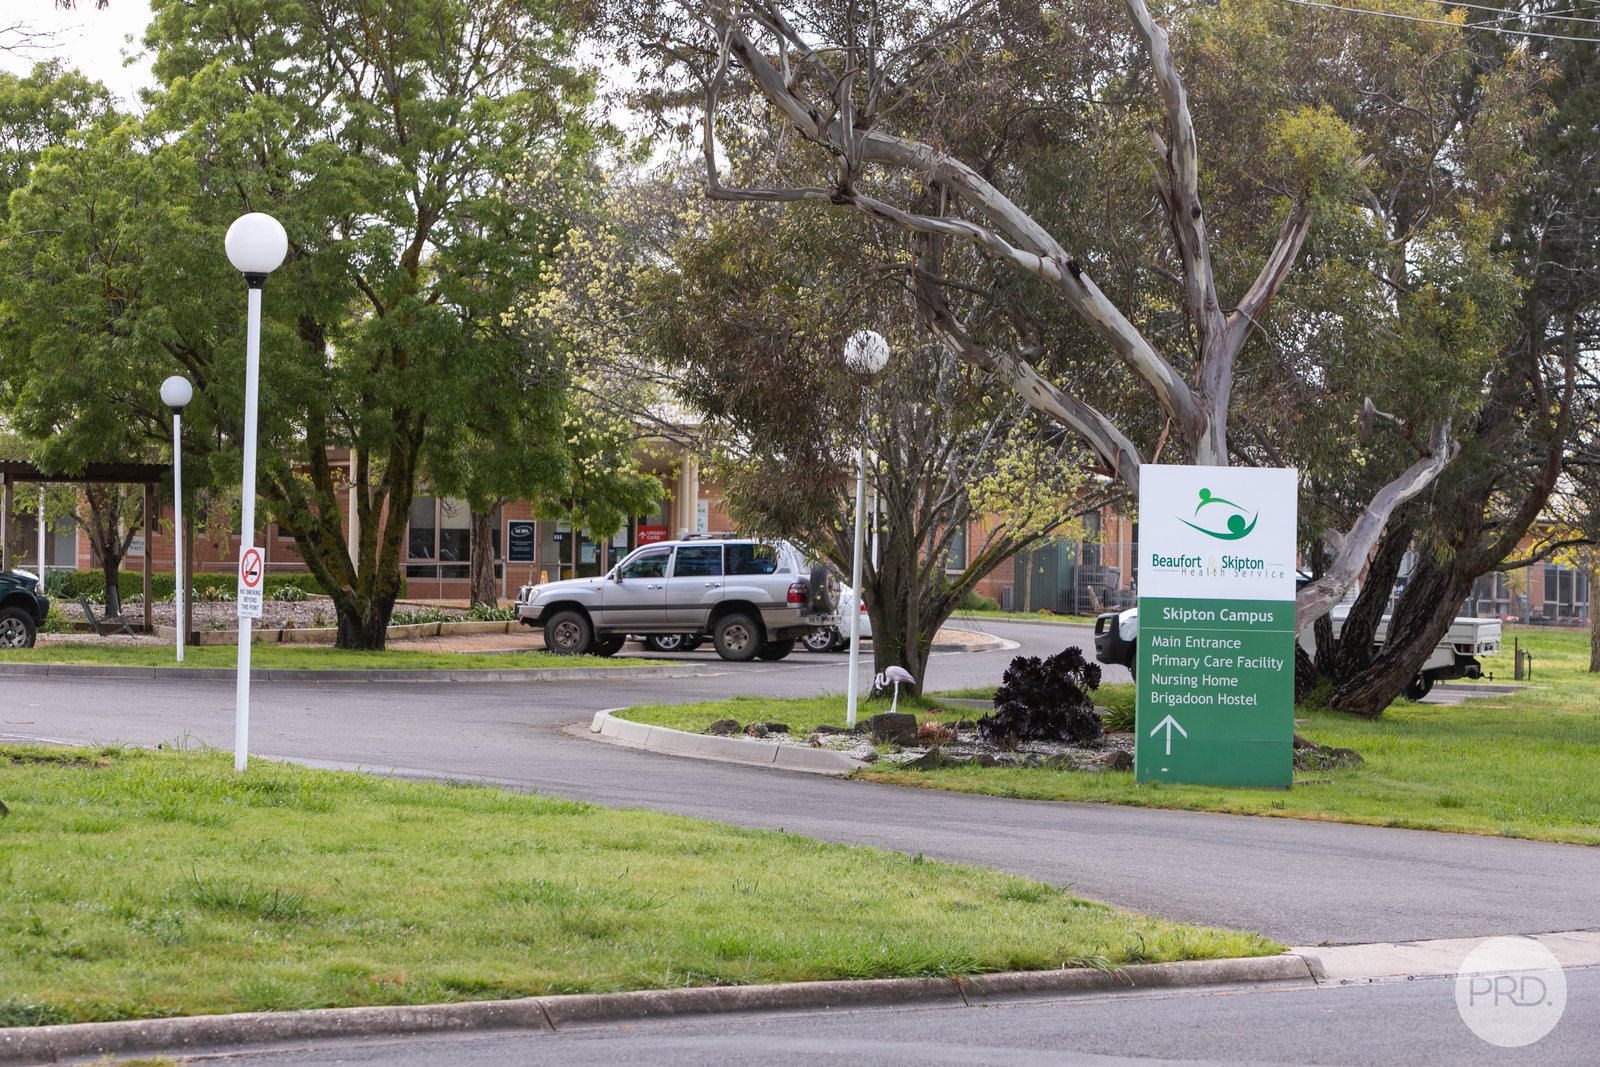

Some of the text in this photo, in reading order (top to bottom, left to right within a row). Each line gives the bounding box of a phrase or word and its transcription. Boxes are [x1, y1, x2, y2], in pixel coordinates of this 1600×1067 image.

[1152, 553, 1202, 568] Beaufort
[1222, 555, 1264, 572] Skipton
[1181, 567, 1285, 579] Health Service
[1163, 607, 1274, 625] Skipton Campus
[1151, 635, 1242, 649] Main Entrance
[1151, 653, 1284, 671] Primary Care Facility
[1151, 673, 1239, 689] Nursing Home
[1151, 691, 1258, 707] Brigadoon Hostel
